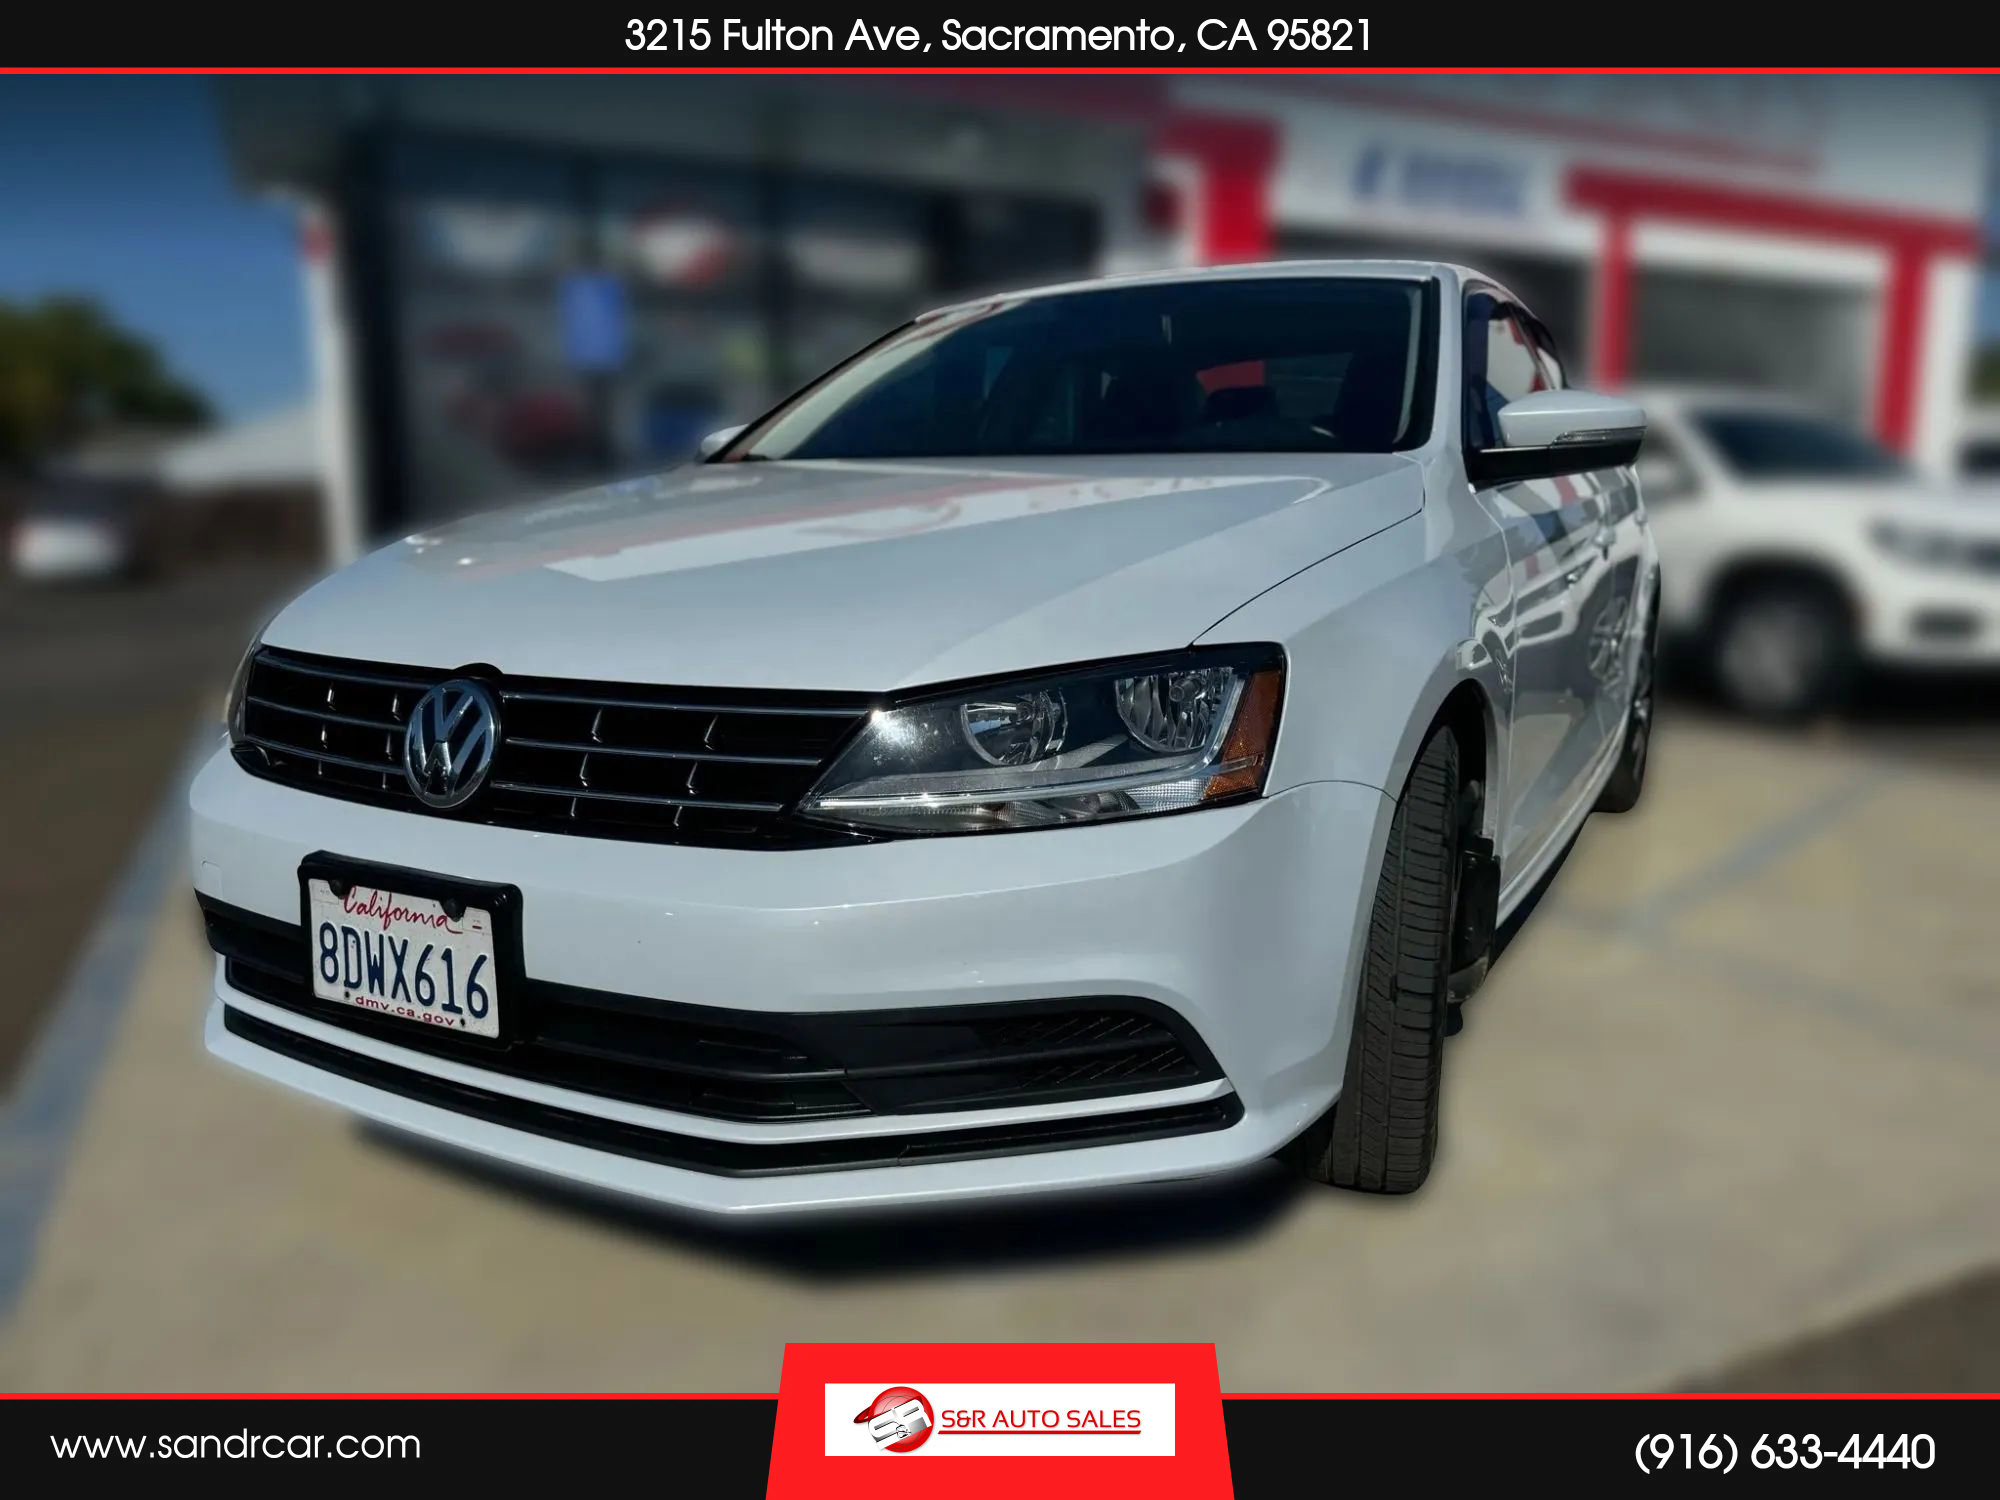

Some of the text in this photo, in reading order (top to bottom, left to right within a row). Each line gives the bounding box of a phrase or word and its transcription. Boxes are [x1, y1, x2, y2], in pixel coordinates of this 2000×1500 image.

[344, 886, 463, 934] California
[319, 921, 489, 1019] 8DWX616
[355, 995, 455, 1027] dmv.ca.gov
